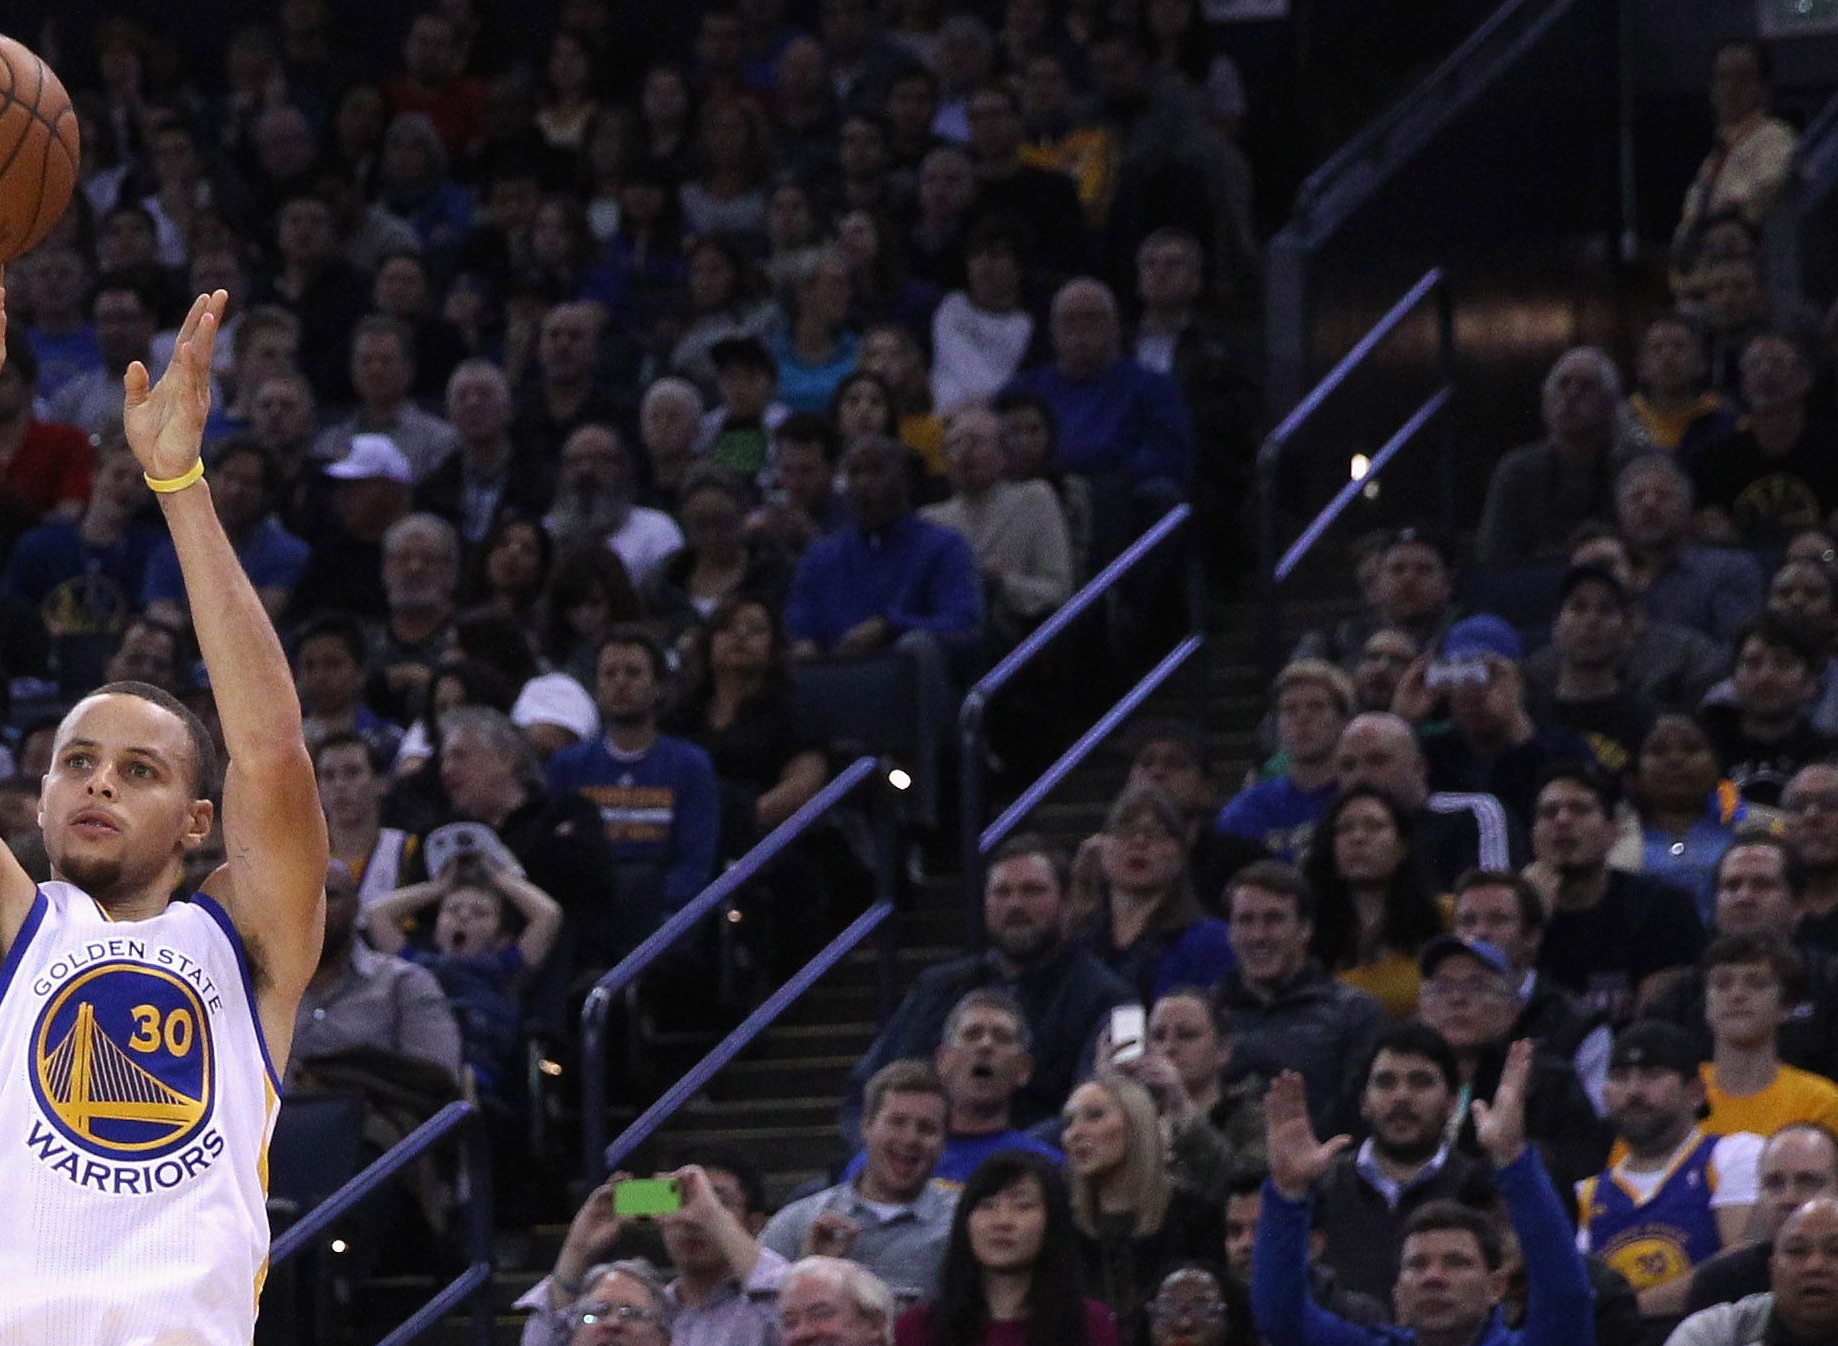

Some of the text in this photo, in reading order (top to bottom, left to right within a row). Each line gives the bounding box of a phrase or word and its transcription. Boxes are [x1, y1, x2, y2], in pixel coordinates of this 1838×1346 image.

[34, 940, 223, 1015] GOLDEN STATE
[128, 1004, 194, 1058] 30
[25, 1119, 226, 1195] WARRIORS
